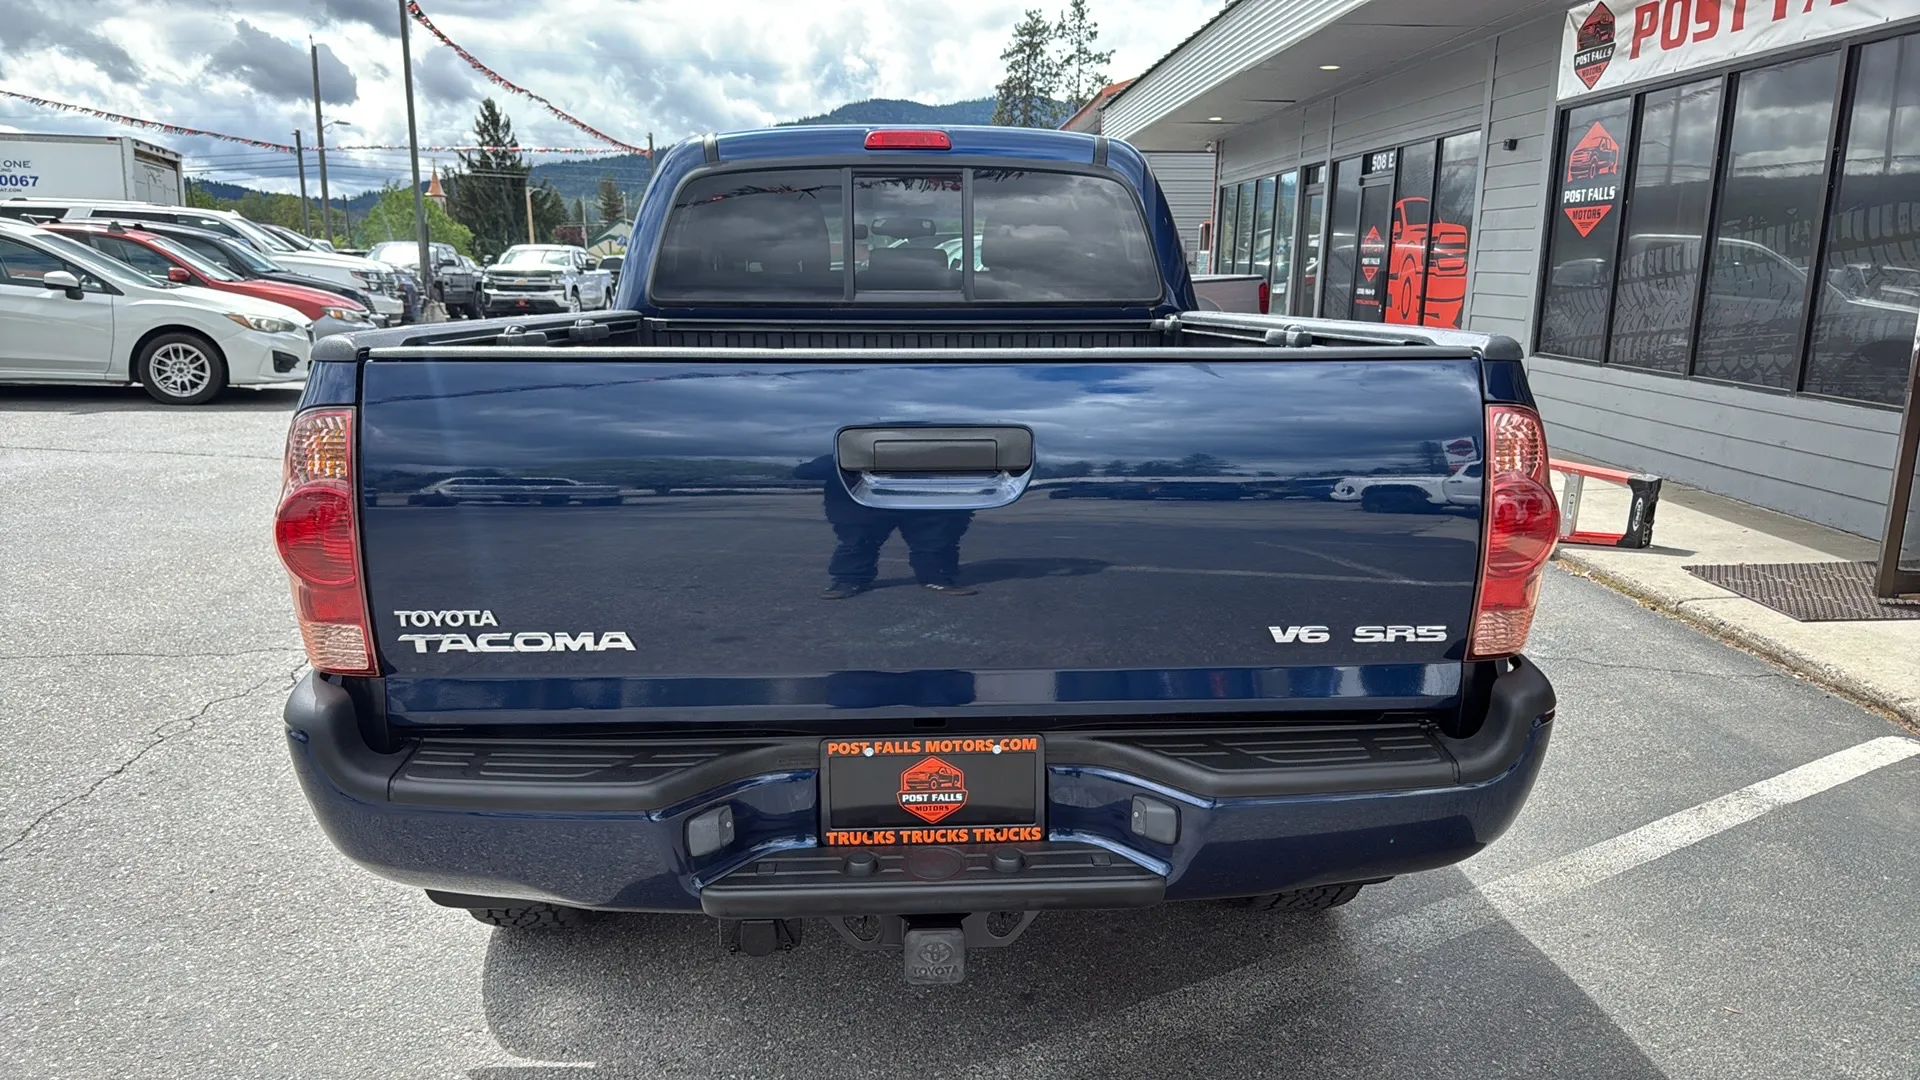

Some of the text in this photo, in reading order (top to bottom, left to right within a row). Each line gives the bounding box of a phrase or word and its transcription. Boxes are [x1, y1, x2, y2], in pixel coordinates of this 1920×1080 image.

[1575, 47, 1613, 67] POST FALLS
[3, 160, 31, 168] ONE
[1371, 153, 1387, 171] 508
[0, 174, 39, 187] 0067
[1563, 185, 1616, 203] POST FALLS
[1572, 208, 1602, 220] MOTORS
[394, 610, 499, 628] TOYOTA
[397, 631, 637, 654] TACOMA
[1268, 625, 1448, 643] V6 SR5
[827, 742, 871, 755] POST
[874, 740, 921, 754] FALLS
[902, 793, 963, 803] POST FALLS
[826, 827, 1042, 846] TRUCKS TRUCKS TRUCKS
[912, 965, 959, 976] TOYOTA
